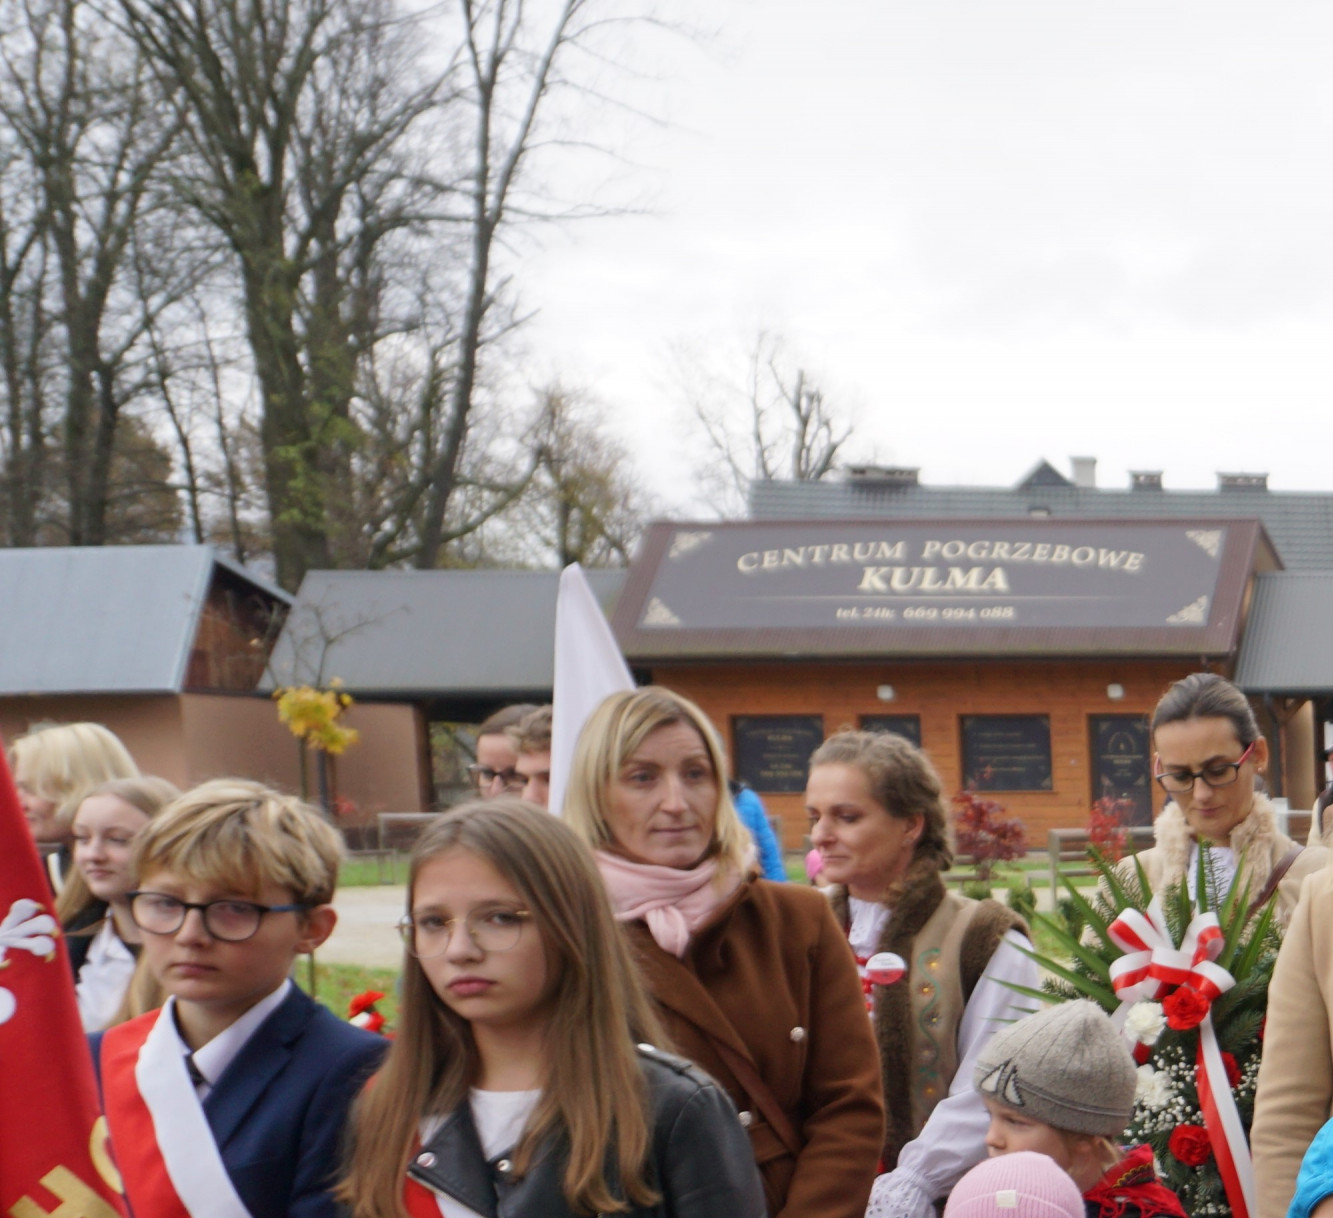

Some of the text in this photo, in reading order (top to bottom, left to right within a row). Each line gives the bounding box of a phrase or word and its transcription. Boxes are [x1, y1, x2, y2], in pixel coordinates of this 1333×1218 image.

[737, 540, 1144, 572] CENTRUM POGRZEBOWE
[857, 566, 1009, 590] KULMA
[903, 607, 937, 620] 669
[942, 607, 975, 620] 994
[980, 606, 1014, 619] 088
